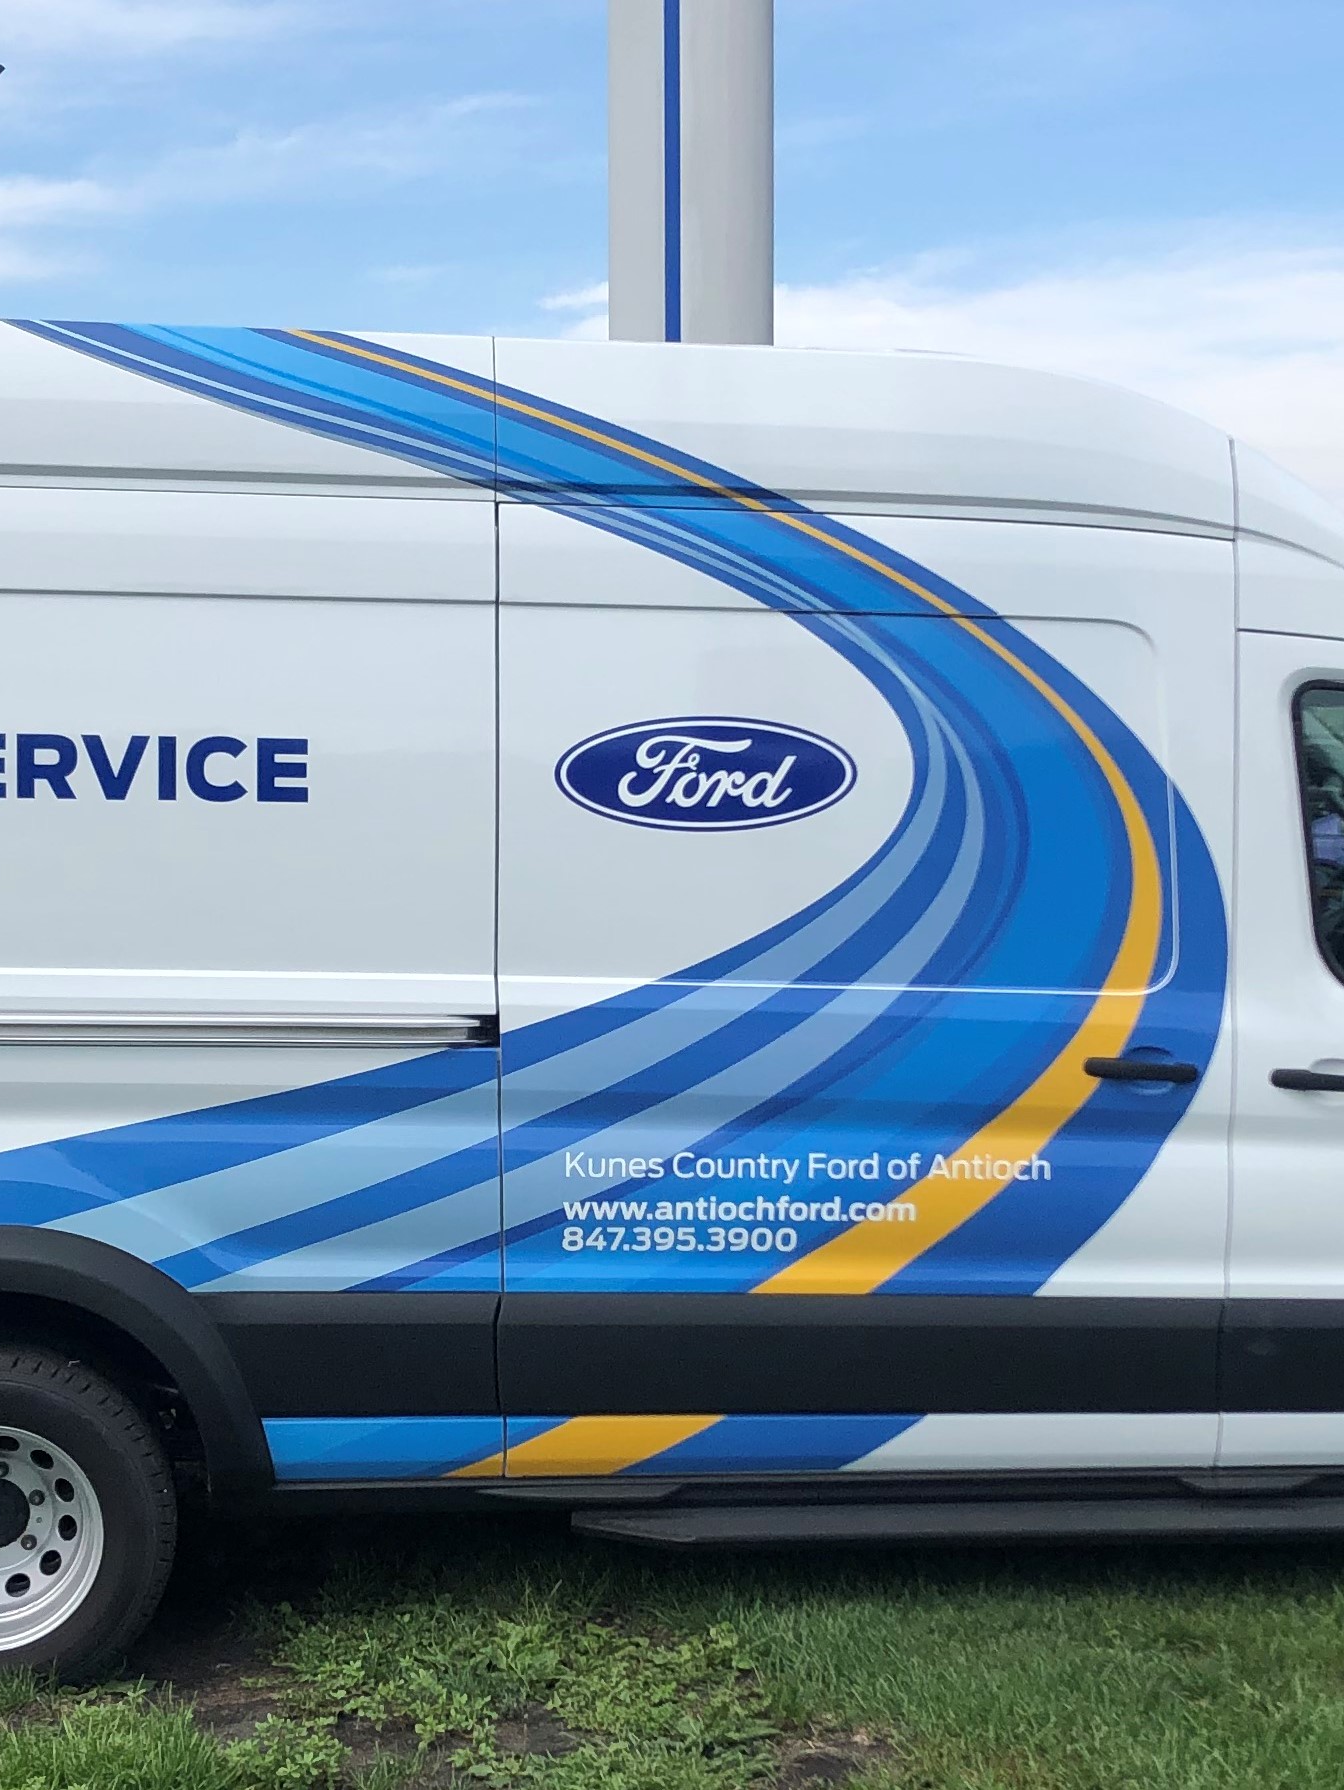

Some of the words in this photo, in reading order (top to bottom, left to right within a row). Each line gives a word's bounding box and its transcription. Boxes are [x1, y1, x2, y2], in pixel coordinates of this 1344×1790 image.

[617, 734, 797, 808] Ford
[564, 1151, 665, 1179] Kunes
[672, 1152, 799, 1185] Country
[808, 1152, 880, 1180] Ford
[887, 1152, 922, 1180] of
[927, 1153, 1052, 1181] Antioch
[562, 1196, 917, 1222] www.antiochford.com
[561, 1226, 798, 1252] 847.395.3900
